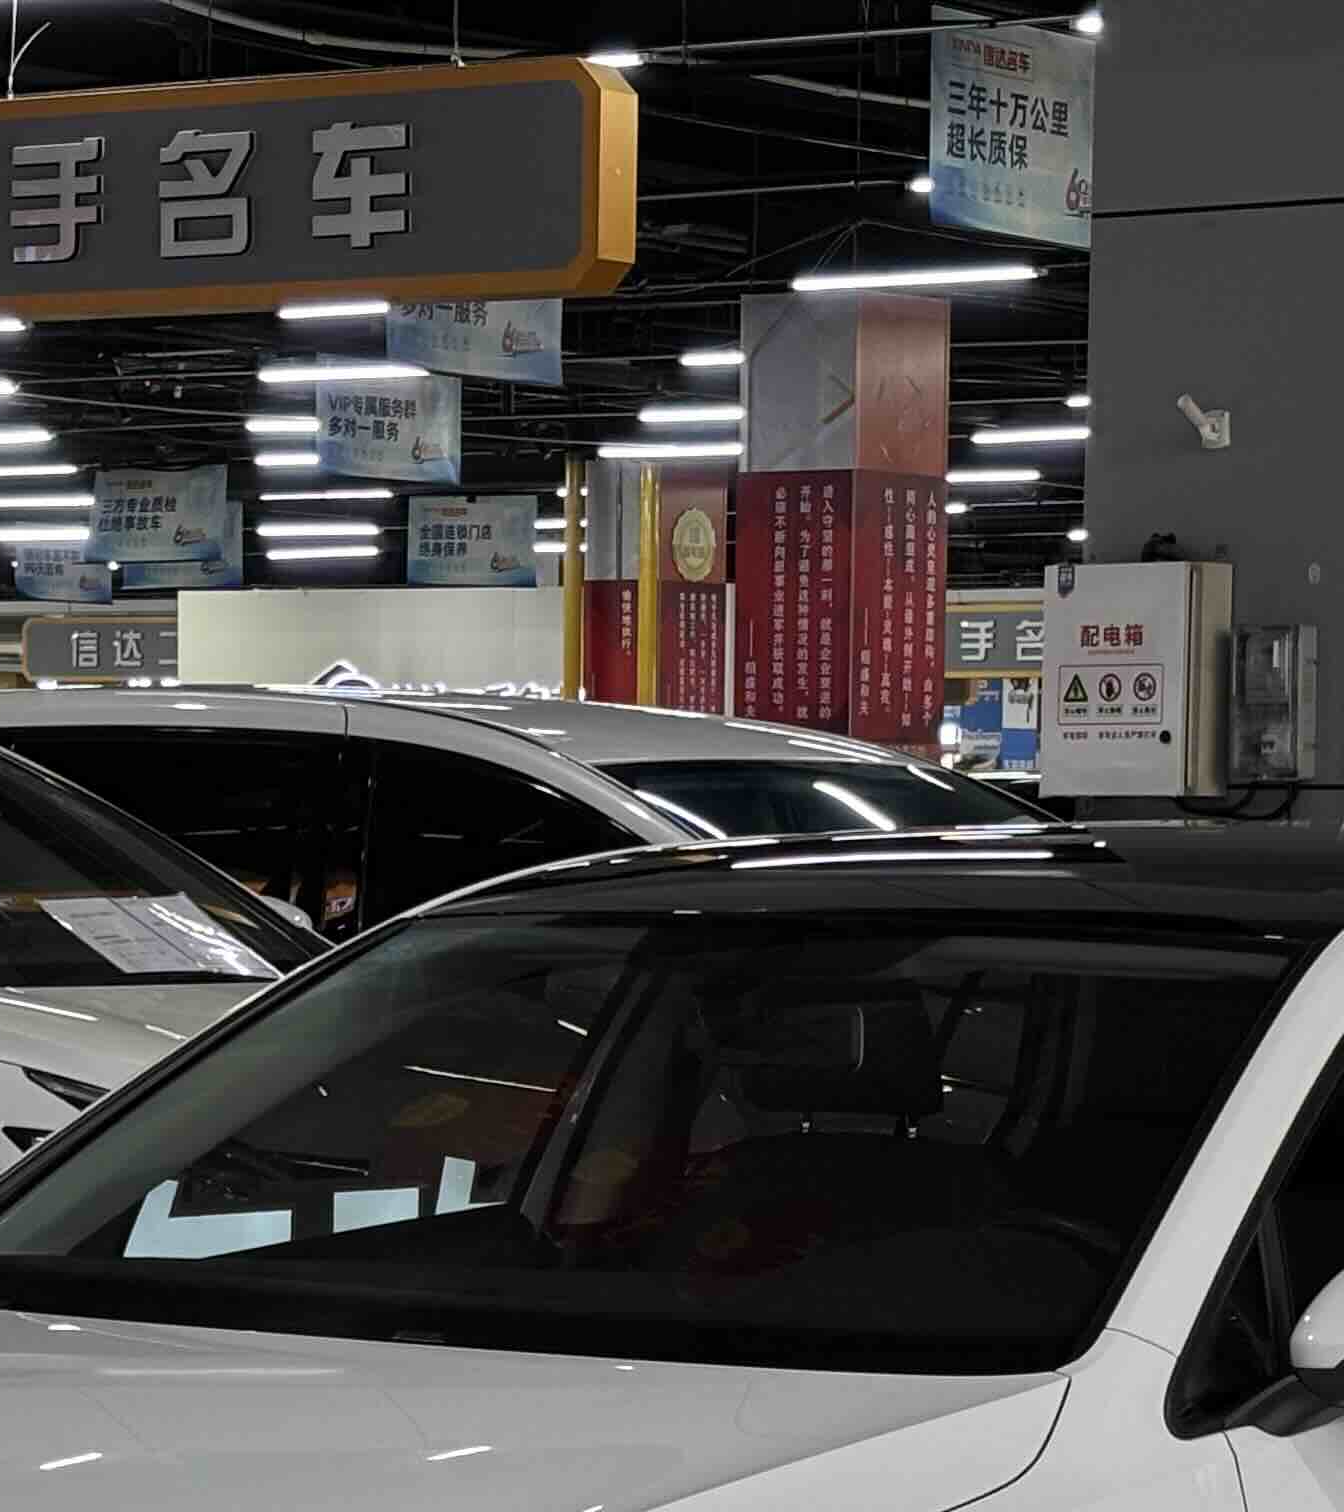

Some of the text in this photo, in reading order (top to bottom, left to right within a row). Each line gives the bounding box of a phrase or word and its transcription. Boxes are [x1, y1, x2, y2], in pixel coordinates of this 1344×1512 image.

[948, 80, 1069, 138] 三年十万公里
[947, 123, 1028, 169] 超长质保
[328, 416, 399, 441] 多对一服务
[1080, 624, 1144, 648] 配电箱
